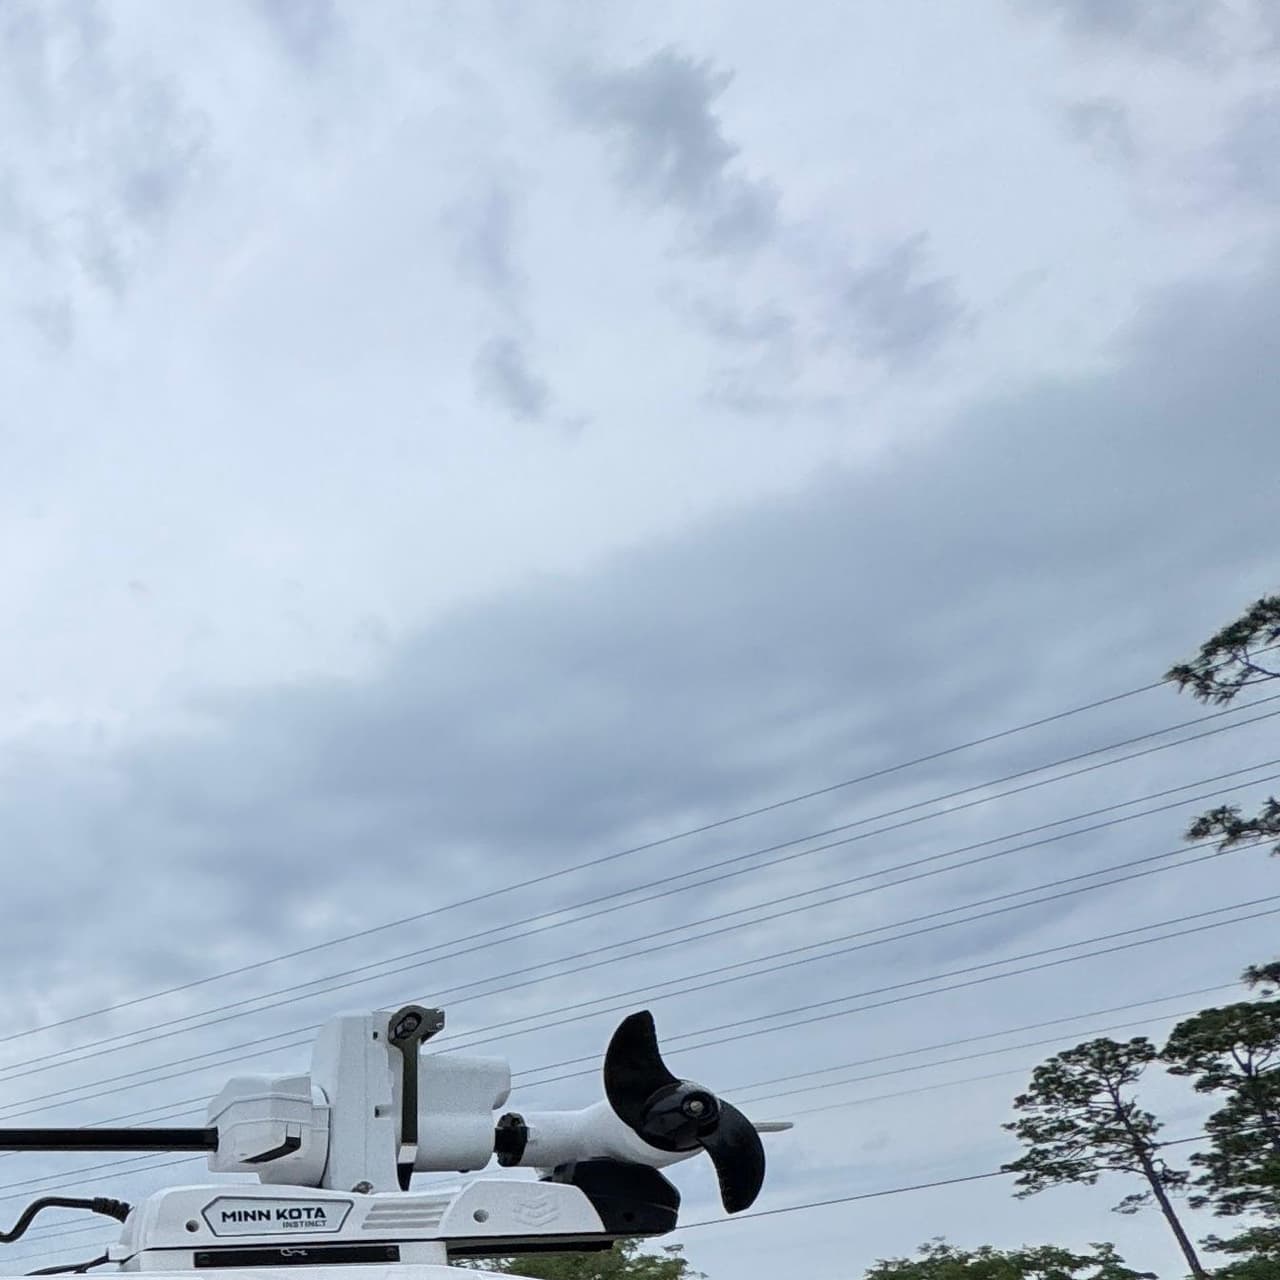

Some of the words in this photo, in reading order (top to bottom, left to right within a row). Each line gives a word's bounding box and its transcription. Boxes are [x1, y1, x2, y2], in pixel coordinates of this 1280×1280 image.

[221, 1208, 271, 1223] MINN
[276, 1207, 327, 1221] KOTA
[282, 1219, 328, 1229] INSTINCT
